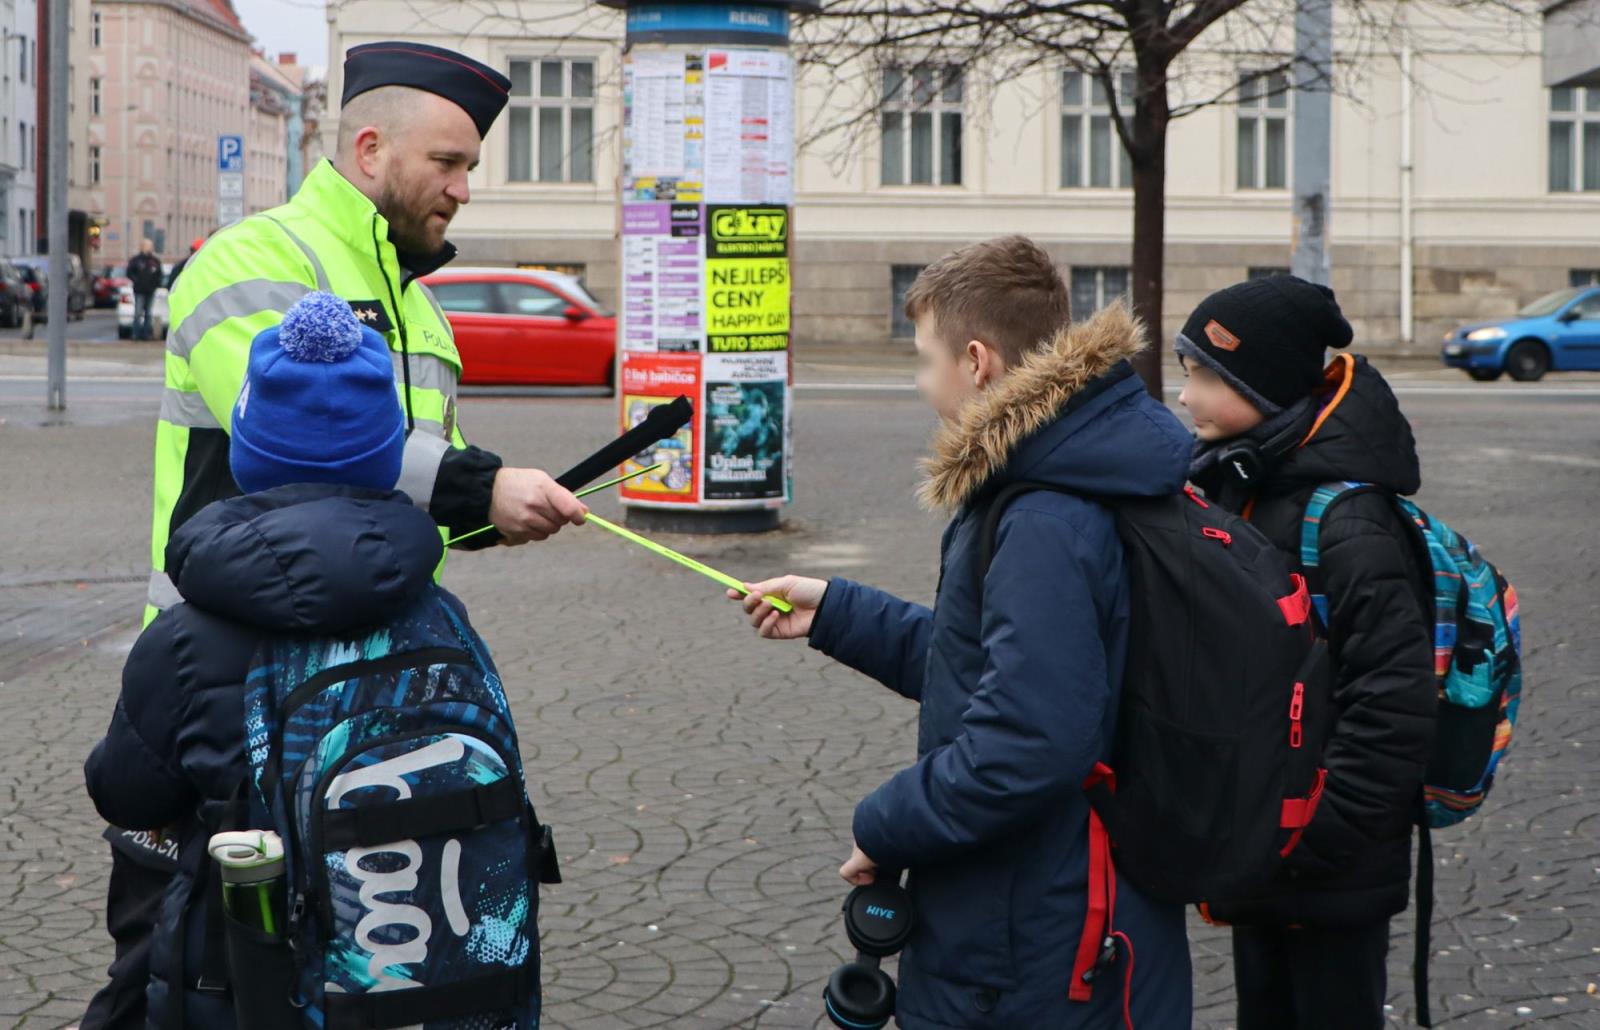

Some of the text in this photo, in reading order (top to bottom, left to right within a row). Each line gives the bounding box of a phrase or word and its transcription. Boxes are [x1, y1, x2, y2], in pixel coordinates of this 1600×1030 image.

[223, 139, 239, 160] P
[712, 290, 765, 309] CENY
[712, 313, 765, 329] HAPPY
[711, 336, 748, 352] TUTO
[866, 905, 895, 919] HIVE
